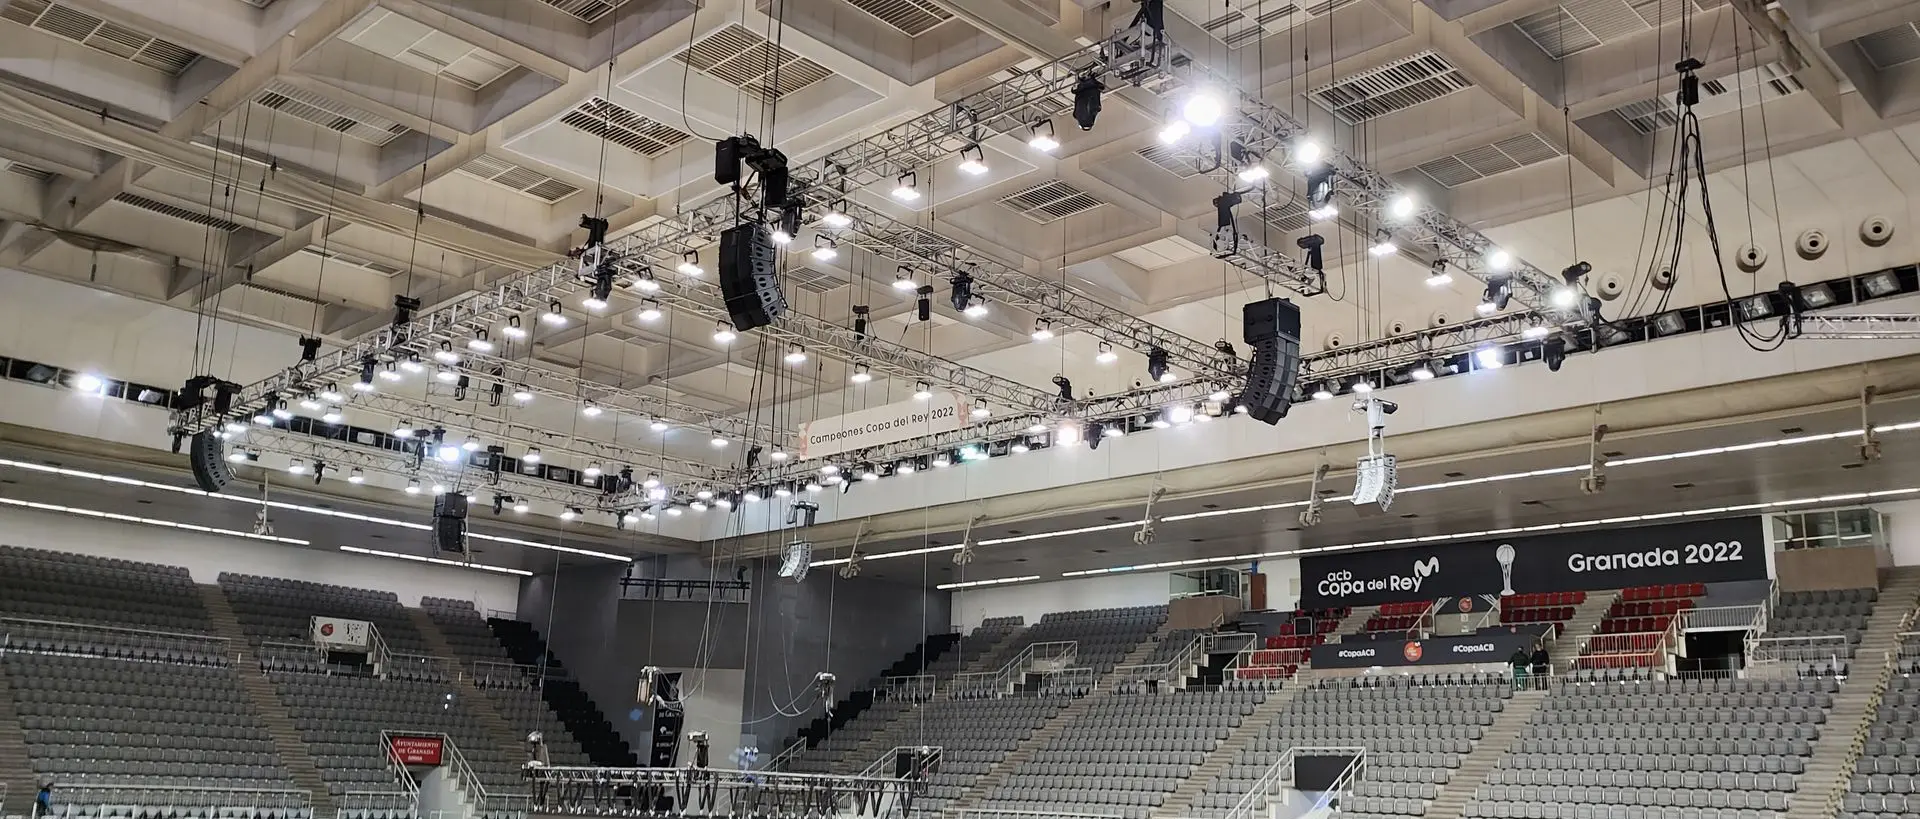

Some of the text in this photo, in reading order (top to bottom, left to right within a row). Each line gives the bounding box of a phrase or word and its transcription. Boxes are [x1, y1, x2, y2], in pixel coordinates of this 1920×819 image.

[810, 406, 954, 444] Campeones Copa del Rey 2022
[1567, 540, 1743, 573] Granada 2022
[1327, 569, 1352, 581] acb
[1318, 575, 1422, 597] Copa del Rey
[1338, 648, 1375, 658] #CopaACB
[1452, 643, 1495, 653] #CopaACB
